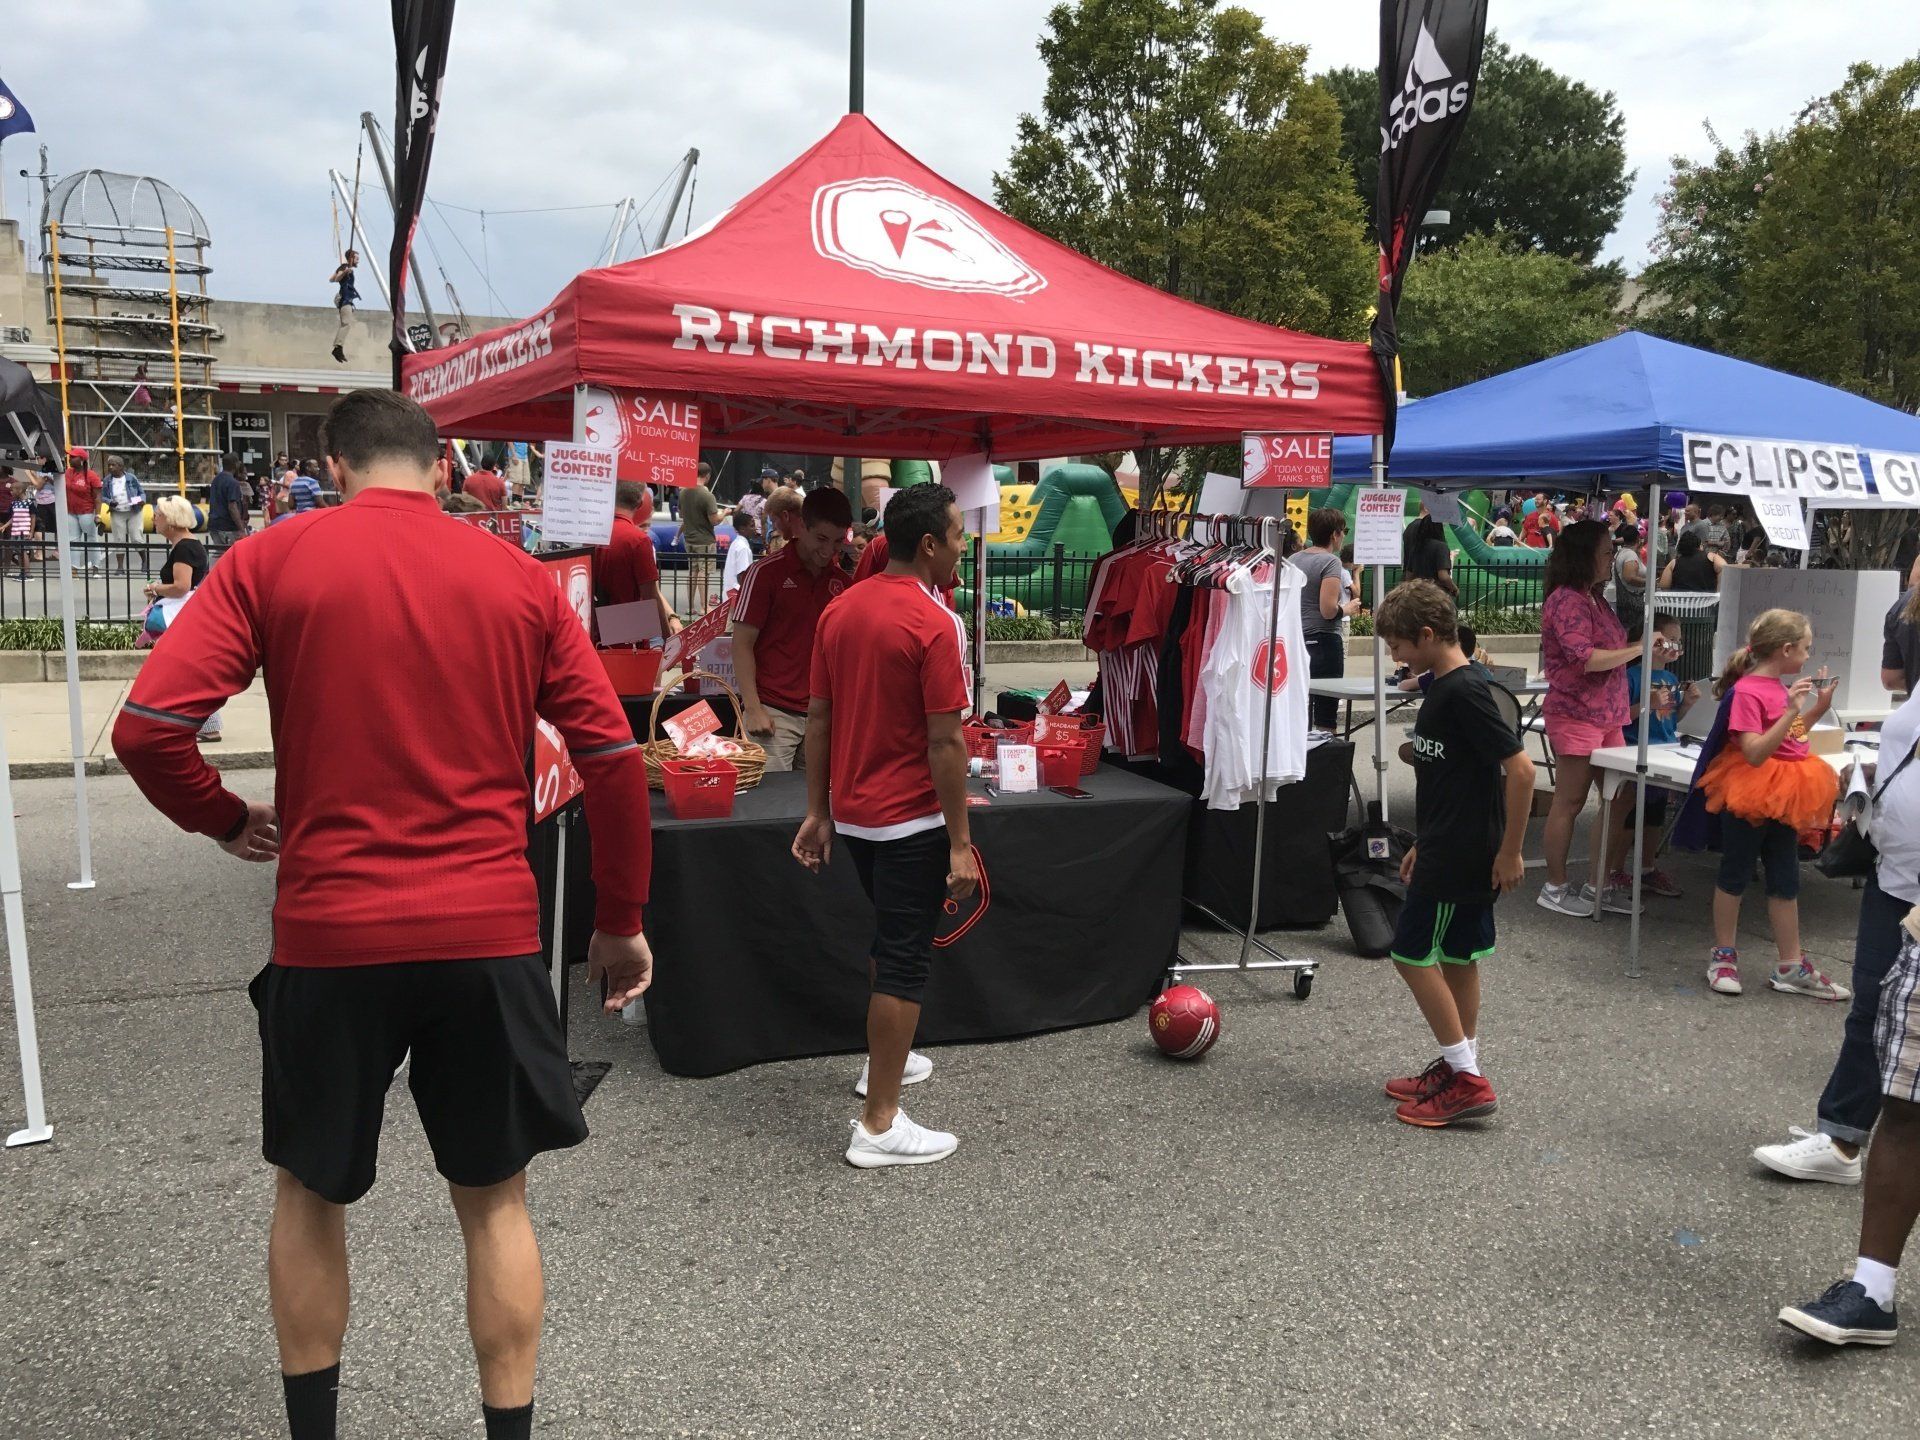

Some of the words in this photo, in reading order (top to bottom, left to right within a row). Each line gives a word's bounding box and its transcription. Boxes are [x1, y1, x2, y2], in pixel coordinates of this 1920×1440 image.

[411, 332, 431, 341] LOVE
[410, 347, 479, 404] RICHMOND
[478, 310, 556, 382] KICKERS
[672, 303, 1056, 379] RICHMOND
[1074, 341, 1320, 400] KICKERS
[632, 396, 698, 430] SALE
[234, 417, 266, 427] 3138
[634, 425, 669, 439] TODAY
[670, 430, 696, 443] ONLY
[551, 448, 612, 465] JUGGLING
[1270, 437, 1331, 459] SALE
[625, 450, 646, 463] ALL
[648, 452, 697, 469] T-SHIRTS
[1688, 439, 1863, 492] ECLIPSE
[551, 461, 612, 479] CONTEST
[651, 466, 675, 483] $15
[1273, 465, 1303, 474] TODAY
[1304, 465, 1328, 474] ONLY
[1310, 475, 1324, 483] $15
[1361, 493, 1402, 502] JUGGLING
[1360, 503, 1400, 513] CONTEST
[1762, 503, 1792, 518] DEBIT
[1767, 526, 1801, 542] CREDIT
[687, 601, 731, 640] SALE
[1049, 722, 1079, 730] HEADBAND
[1055, 730, 1069, 742] $5
[1413, 735, 1446, 760] NDER
